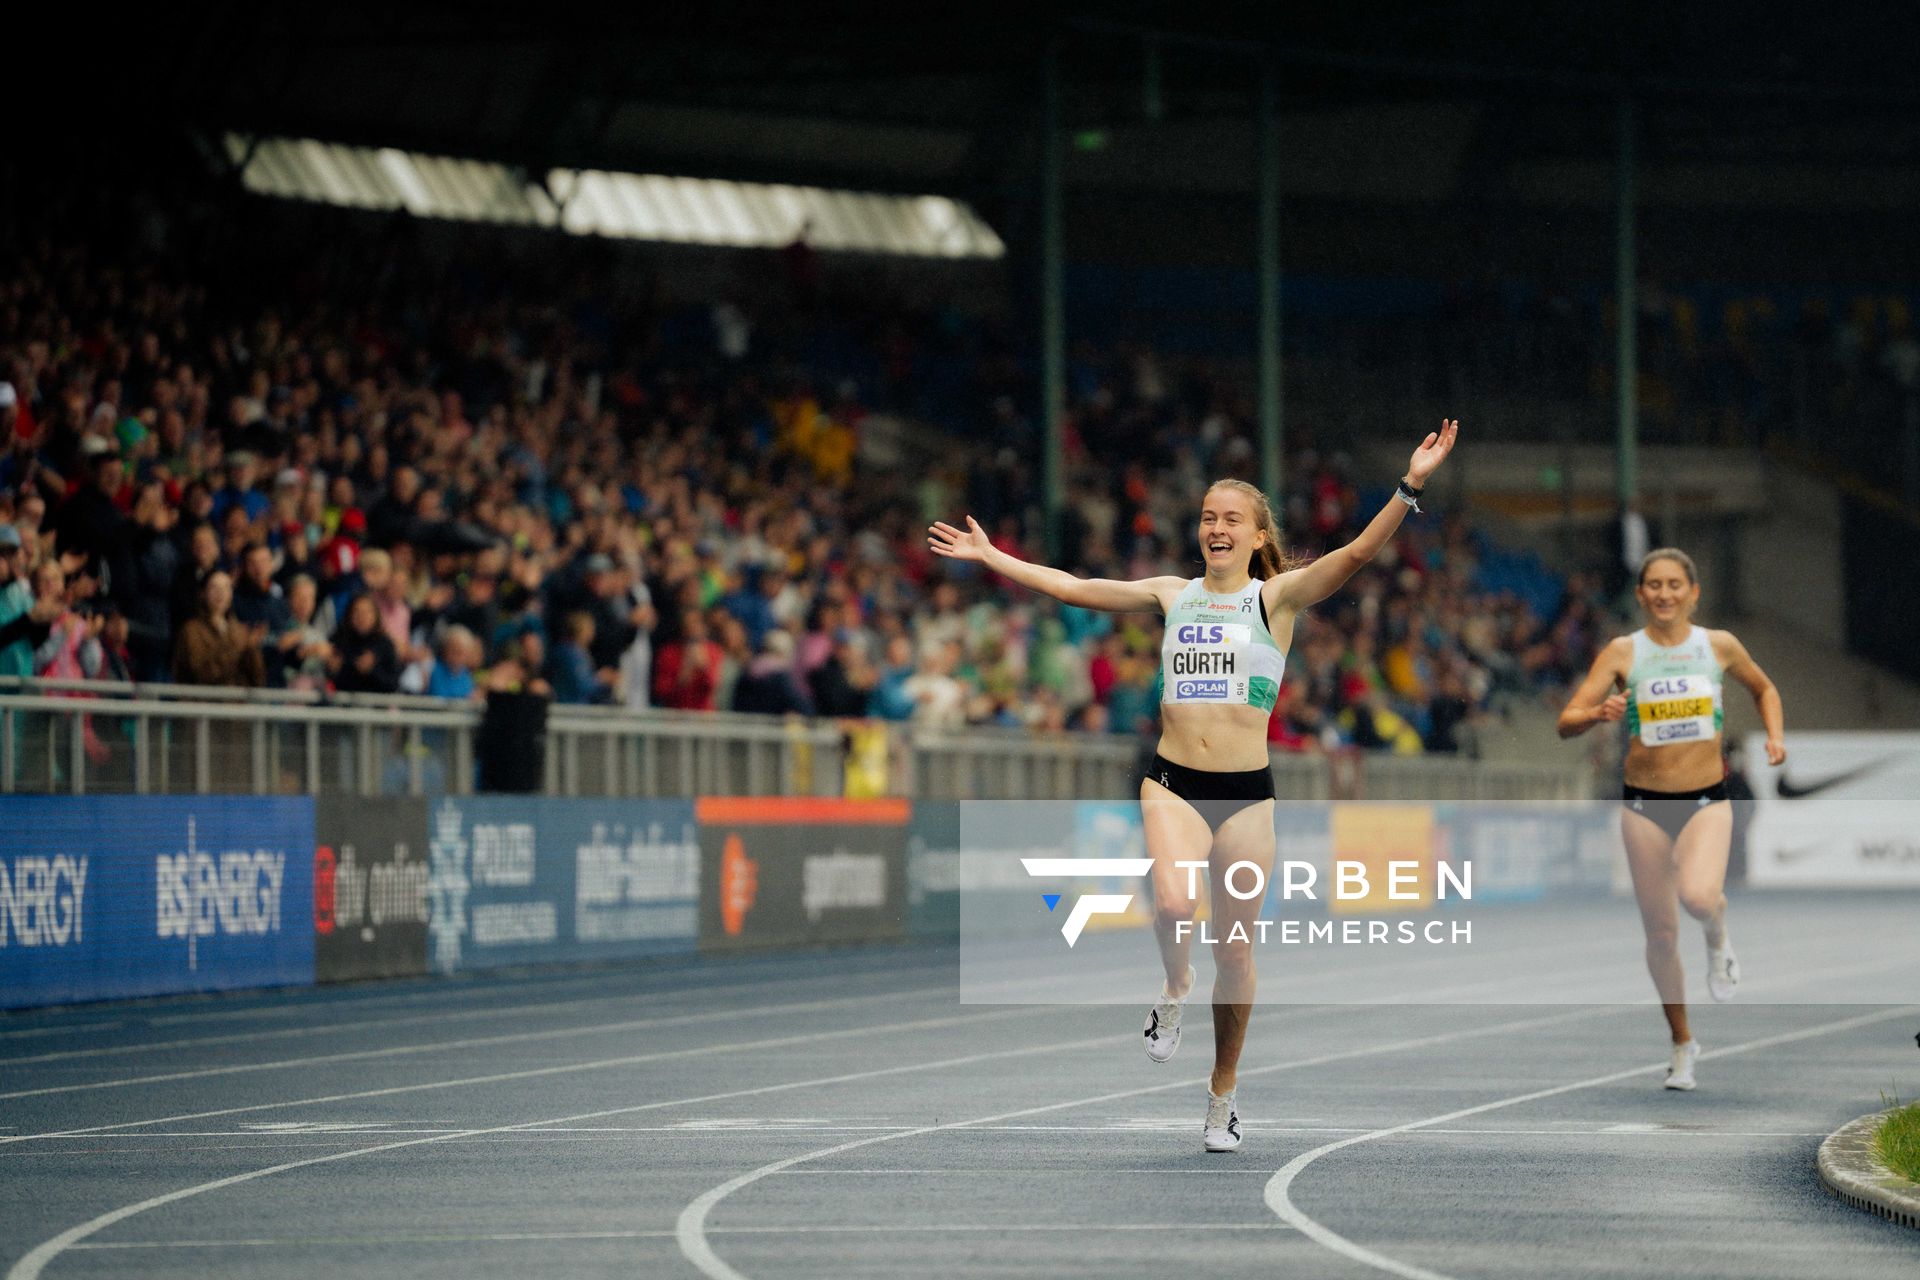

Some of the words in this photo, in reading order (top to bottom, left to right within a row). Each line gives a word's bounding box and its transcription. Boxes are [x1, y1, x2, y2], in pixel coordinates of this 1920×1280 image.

[1173, 648, 1235, 675] GÜRTH
[1197, 683, 1226, 692] PLAN
[1236, 682, 1244, 696] 915
[1649, 699, 1704, 720] KRAUSE
[0, 853, 88, 947] NERGY
